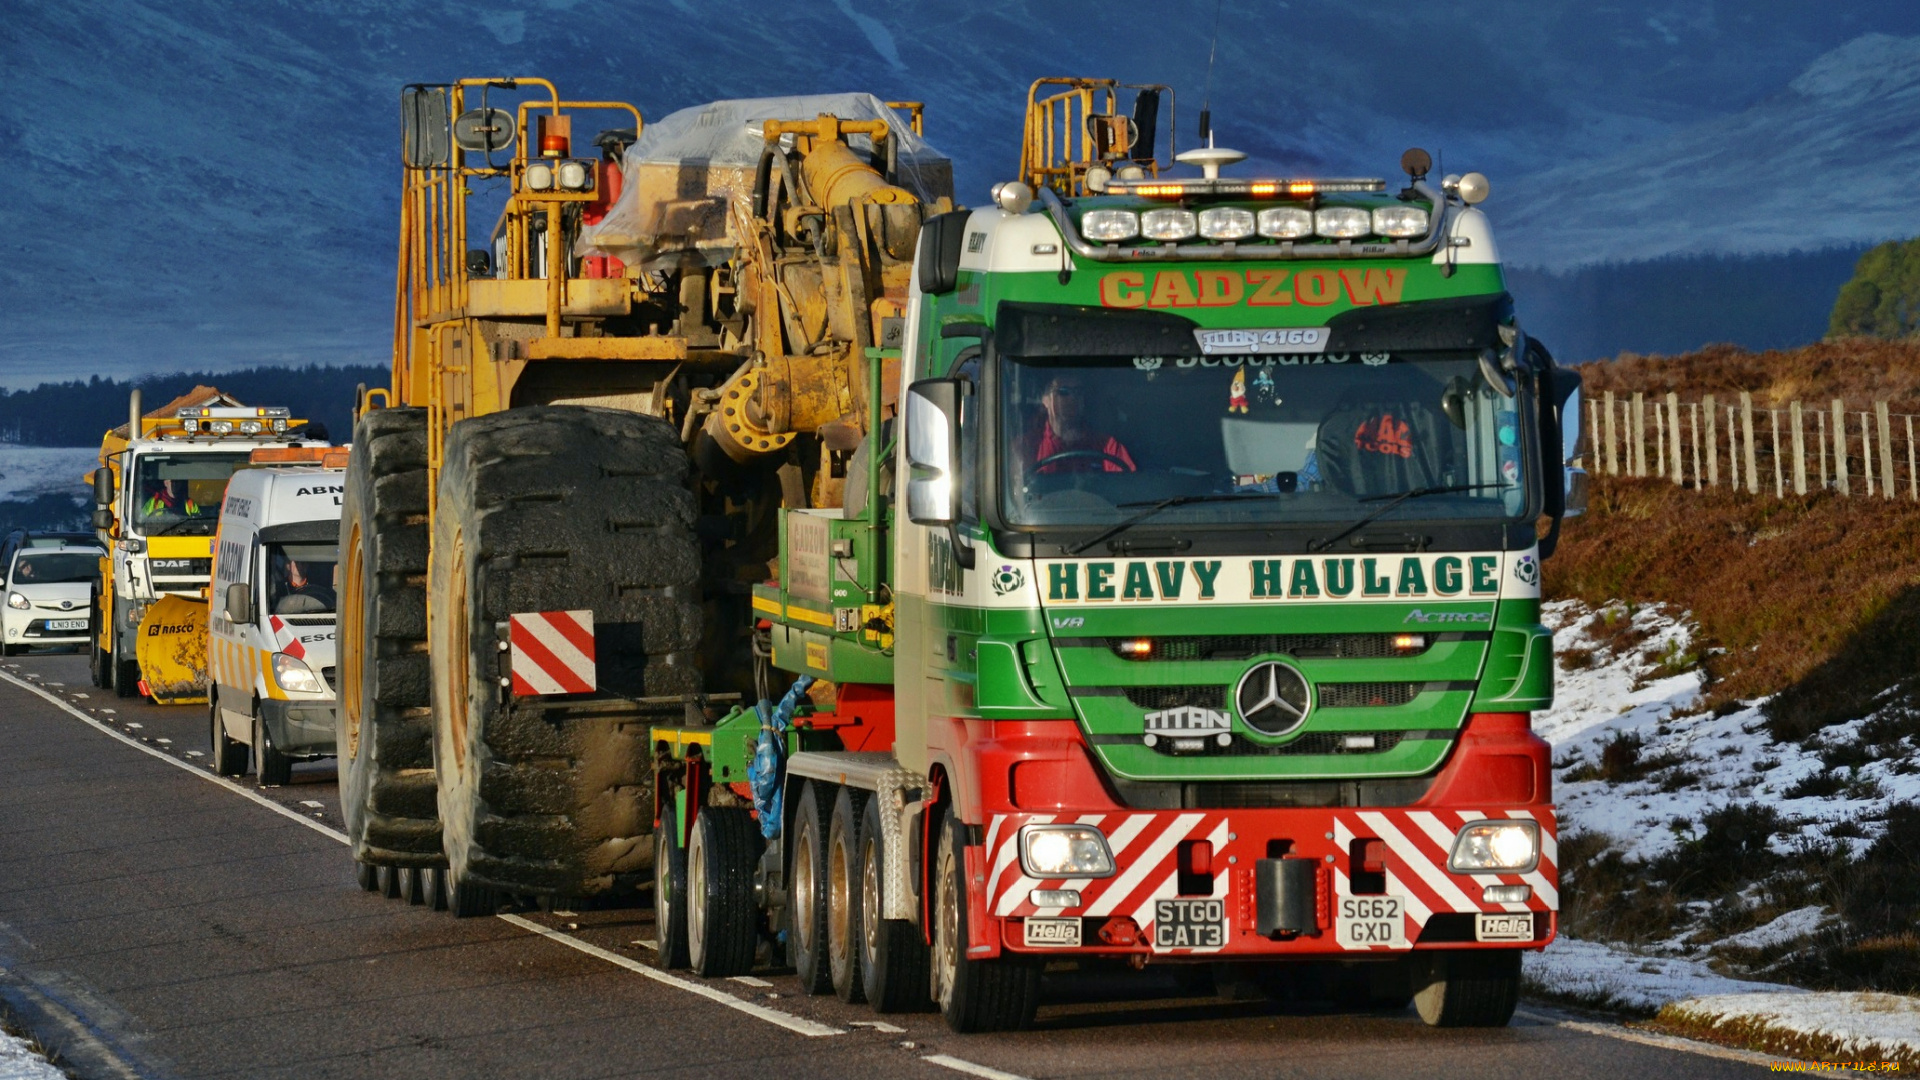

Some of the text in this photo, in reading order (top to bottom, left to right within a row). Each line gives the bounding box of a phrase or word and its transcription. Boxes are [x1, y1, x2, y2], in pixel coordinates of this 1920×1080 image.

[1099, 269, 1408, 309] CADZOW
[1202, 330, 1319, 347] TITAN 4160
[153, 560, 190, 568] DAF
[1046, 556, 1498, 603] HEAVY HAULAGE
[162, 624, 195, 635] RASCO
[1053, 617, 1084, 629] V8
[1144, 706, 1231, 729] TITAN
[1158, 901, 1221, 923] STGO
[1344, 900, 1398, 919] SG62
[1031, 924, 1076, 938] Hella
[1158, 925, 1221, 946] CAT3
[1351, 922, 1392, 941] GXD
[1485, 920, 1528, 933] Hella
